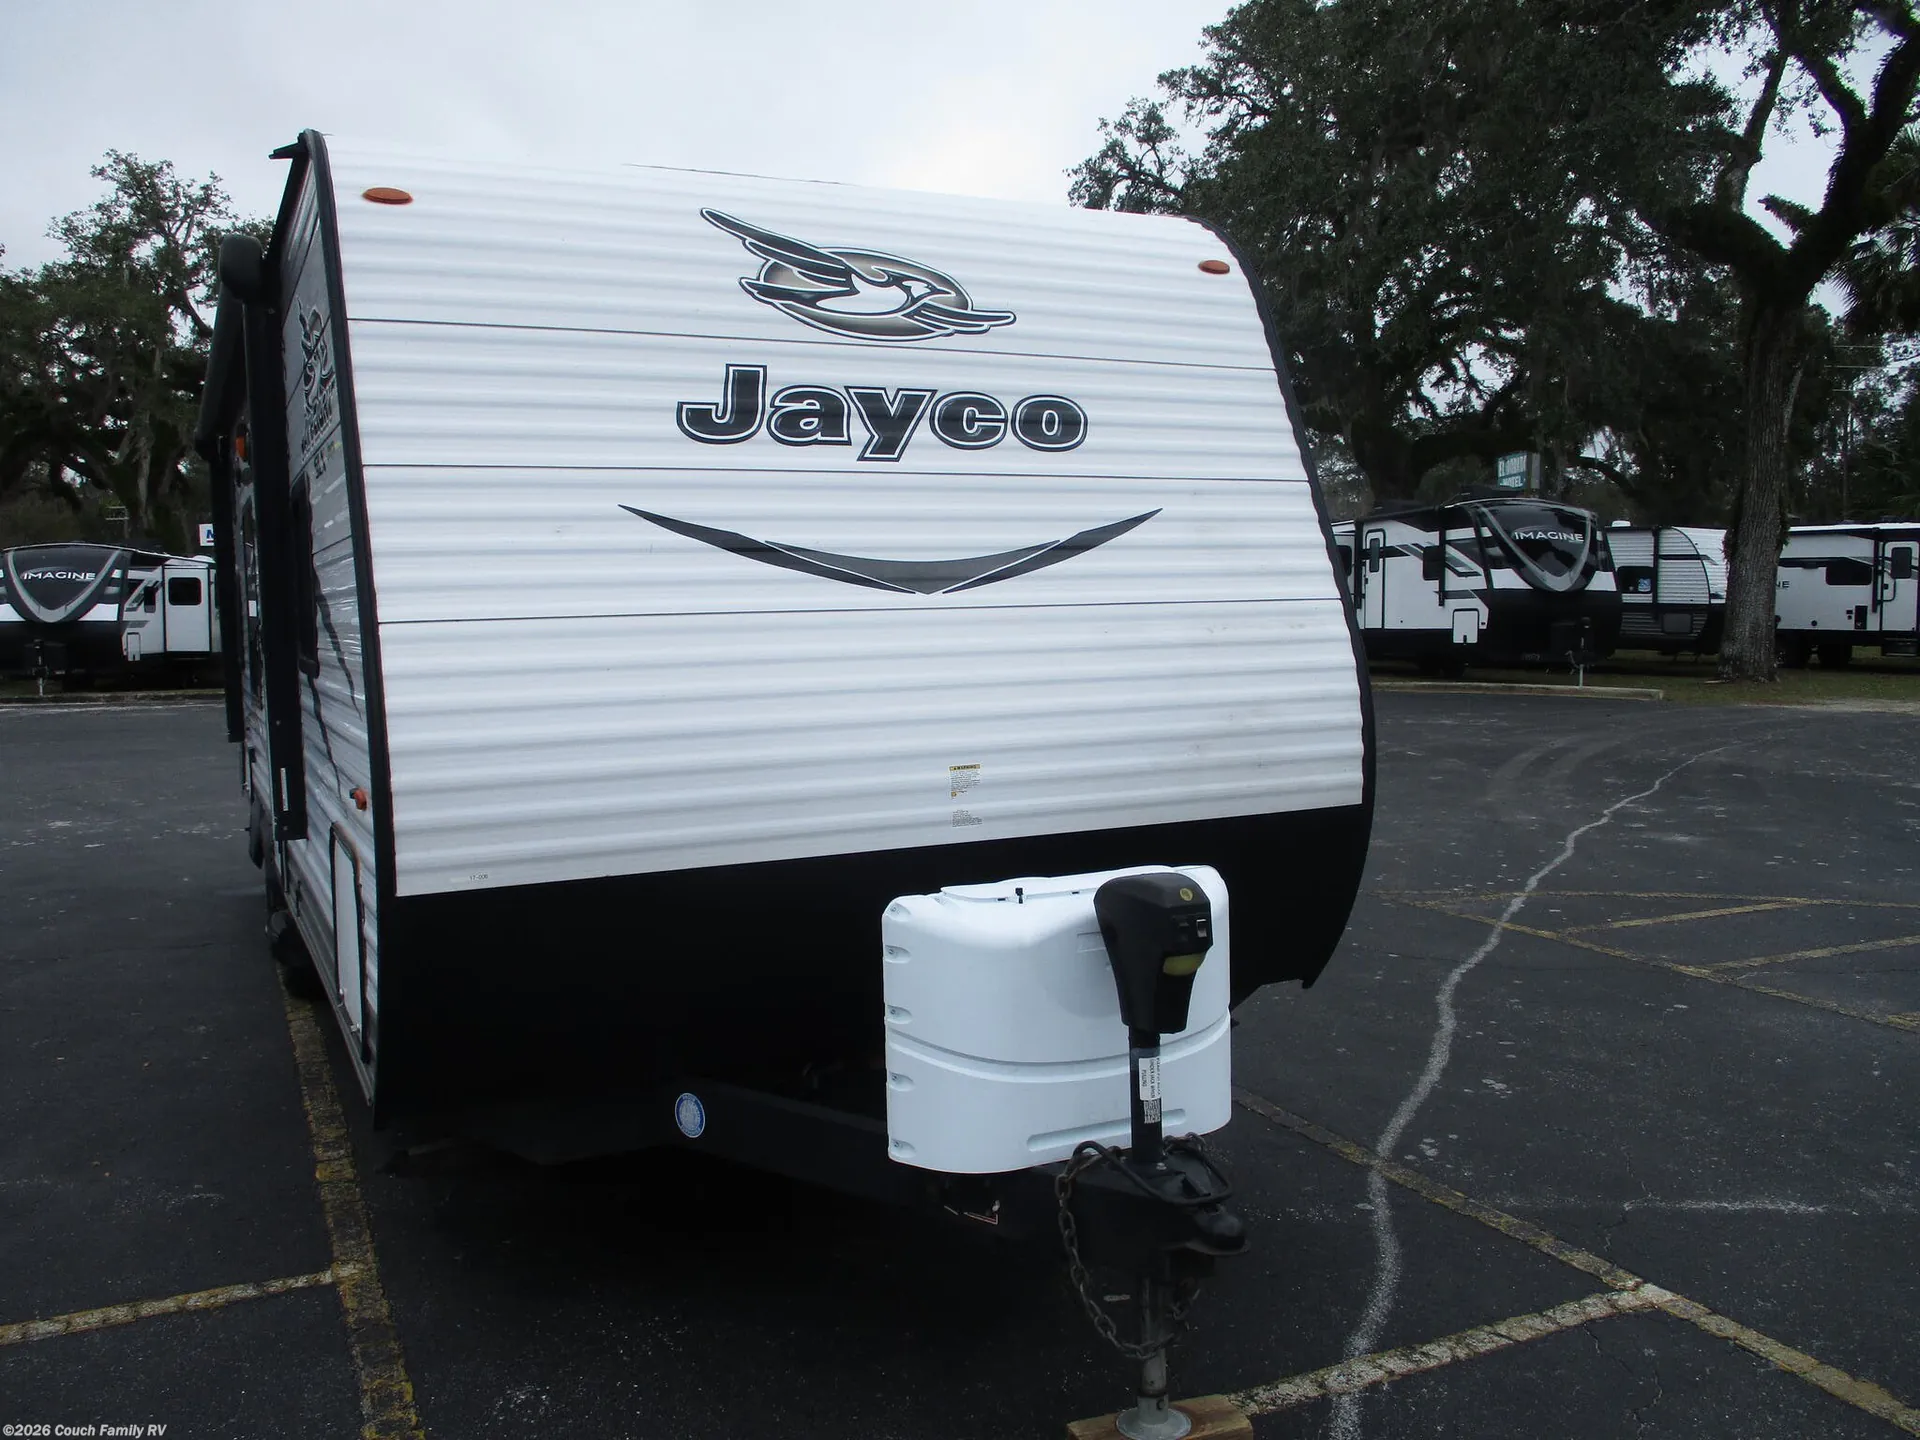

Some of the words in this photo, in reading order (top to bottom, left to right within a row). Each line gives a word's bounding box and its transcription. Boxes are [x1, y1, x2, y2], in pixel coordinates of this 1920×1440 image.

[677, 364, 1088, 462] Jayco
[1514, 531, 1584, 542] IMAGINE
[23, 571, 96, 580] IMAGINE
